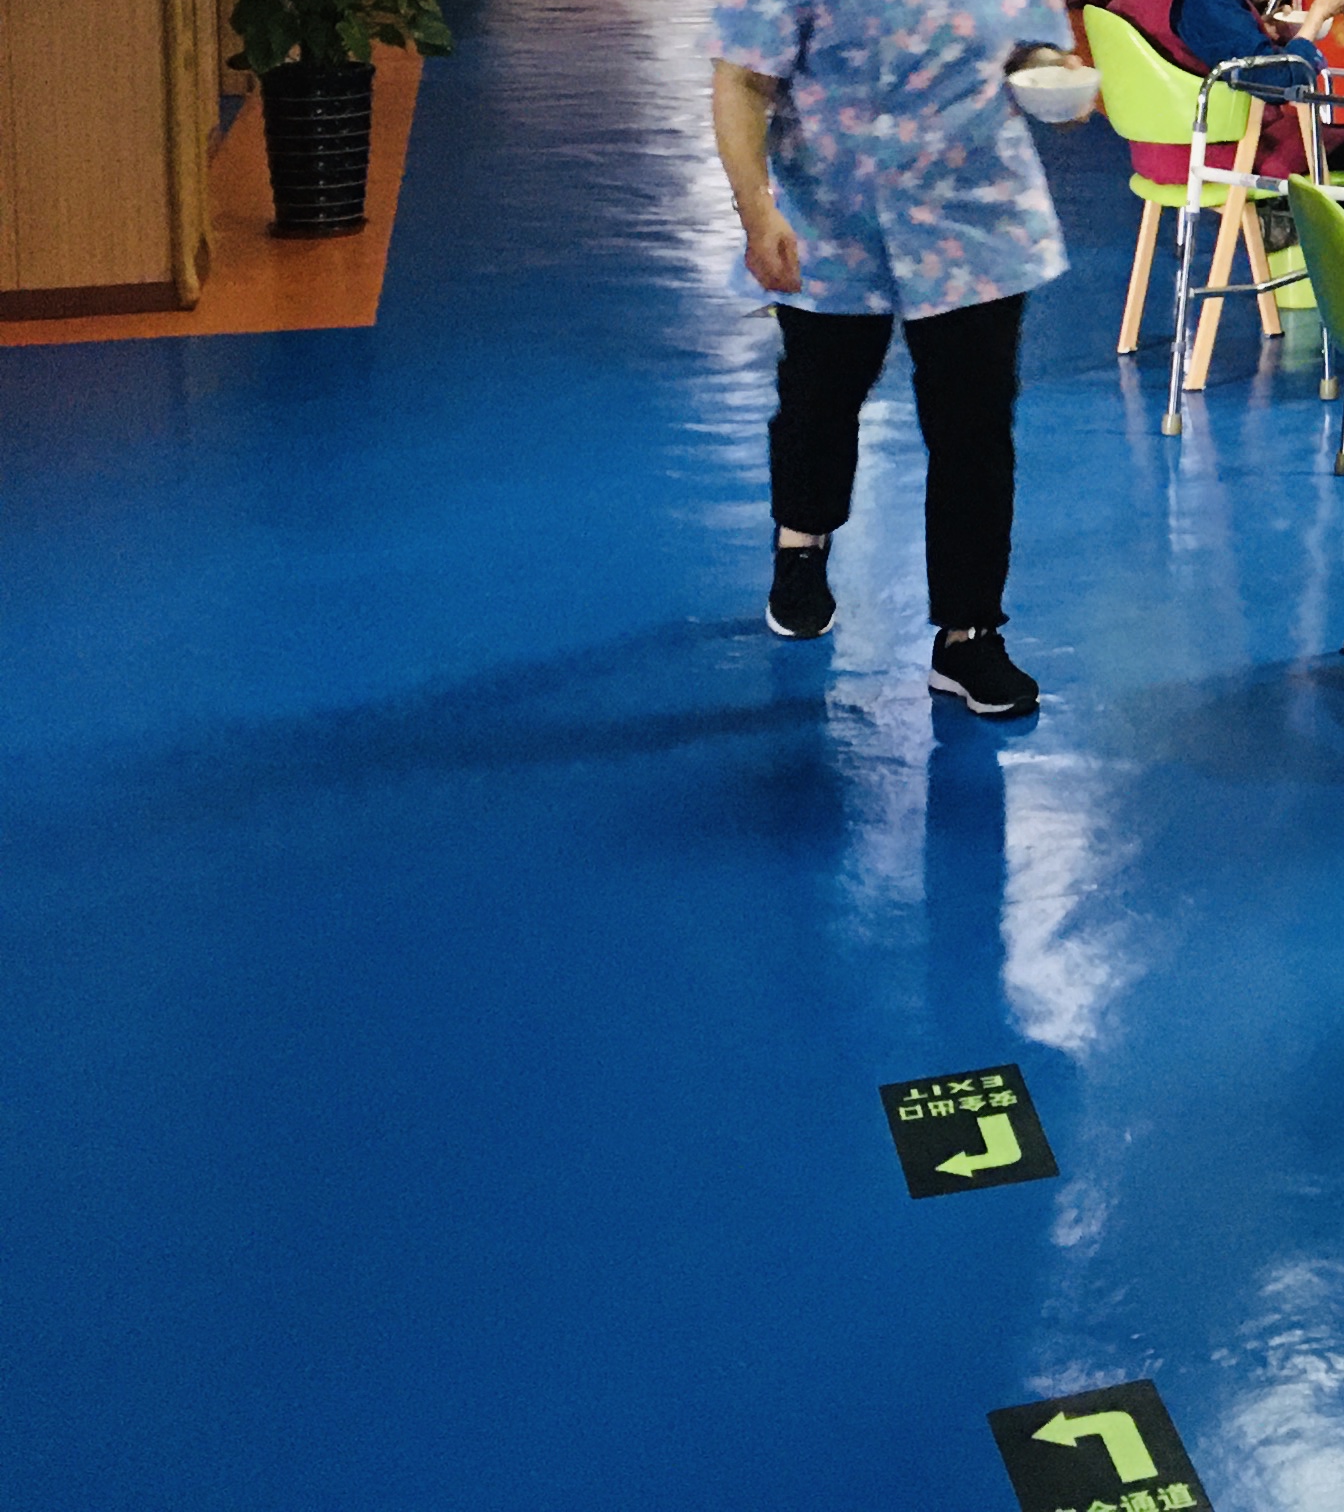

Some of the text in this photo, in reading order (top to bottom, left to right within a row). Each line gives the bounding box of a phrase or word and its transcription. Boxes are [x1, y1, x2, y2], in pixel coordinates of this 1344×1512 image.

[903, 1075, 1003, 1101] EXIT
[899, 1089, 1018, 1120] 安全出口
[1055, 1483, 1197, 1512] 通道
